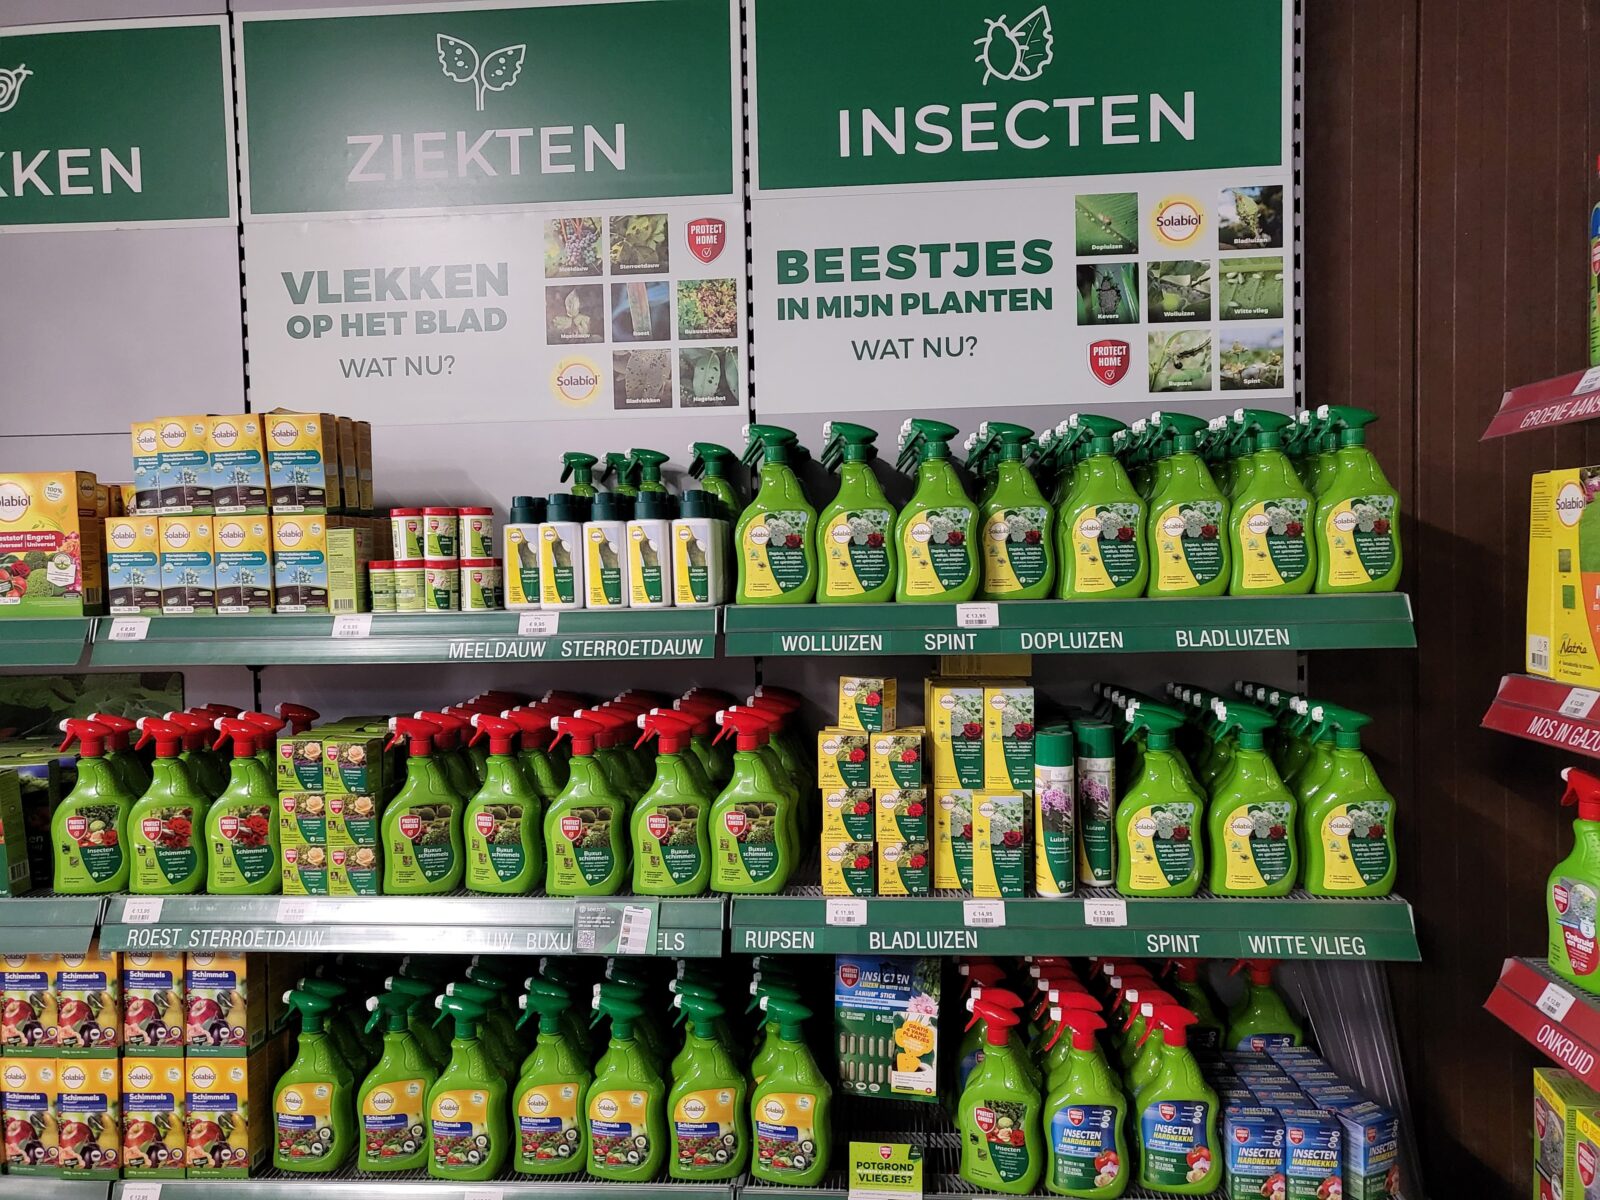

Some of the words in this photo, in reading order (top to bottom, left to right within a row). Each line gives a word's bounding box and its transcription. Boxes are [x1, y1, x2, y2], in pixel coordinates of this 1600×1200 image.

[839, 91, 1196, 158] INSECTEN
[346, 123, 628, 184] ZIEKTEN
[1157, 215, 1201, 226] Solabiol
[691, 224, 722, 234] PROTECT
[696, 235, 717, 244] HOME
[777, 238, 1054, 286] BEESTJES
[280, 261, 510, 306] VLEKKEN
[777, 297, 809, 321] IN
[817, 292, 893, 319] MIJN
[901, 287, 1053, 316] PLANTEN
[286, 313, 334, 341] OP
[340, 309, 411, 338] HET
[415, 305, 508, 336] BLAD
[851, 336, 914, 361] WAT
[922, 335, 979, 358] NU?
[1093, 346, 1127, 356] PROTECT
[339, 355, 397, 380] WAT
[403, 353, 457, 378] NU?
[1098, 357, 1121, 366] HOME
[556, 375, 598, 386] Solabiol
[1520, 402, 1572, 428] GROENE
[212, 430, 238, 438] Solabiol
[272, 429, 298, 437] Solabiol
[1556, 497, 1586, 510] Solabiol
[27, 534, 55, 542] Engrais
[112, 531, 136, 540] Solabiol
[164, 531, 191, 539] Solabiol
[219, 531, 246, 539] Solabiol
[277, 530, 303, 538] Solabiol
[782, 635, 882, 652] WOLLUIZEN
[924, 633, 977, 650] SPINT
[1020, 631, 1124, 650] DOPLUIZEN
[1176, 628, 1290, 648] BLADLUIZEN
[449, 641, 547, 659] MEELDAUW
[561, 638, 704, 658] STERROETDAUW
[1527, 716, 1558, 738] MOS
[1554, 722, 1571, 742] IN
[126, 928, 182, 947] ROEST
[188, 930, 325, 949] STERROETDAUW
[526, 932, 571, 949] BUXU
[745, 930, 815, 950] RUPSEN
[869, 930, 978, 950] BLADLUIZEN
[1147, 934, 1200, 952] SPINT
[1565, 931, 1594, 948] Onkruid
[1248, 935, 1308, 955] WITTE
[1310, 936, 1366, 956] VLIEG
[1567, 939, 1575, 947] en
[1577, 944, 1592, 954] mos
[909, 1023, 928, 1033] GRATIS
[1536, 1024, 1594, 1074] ONKRUID
[976, 1109, 993, 1118] PROTECT
[1063, 1128, 1101, 1139] INSECTEN
[1155, 1124, 1193, 1135] INSECTEN
[1062, 1137, 1101, 1146] HARDNEKKIG
[1153, 1132, 1193, 1142] HARDNEKKIG
[995, 1145, 1021, 1153] Insecten
[1239, 1148, 1281, 1157] INSECTEN
[1369, 1139, 1397, 1156] INSECTEN
[1293, 1148, 1337, 1160] INSECTEN
[856, 1161, 914, 1171] POTGROND
[1237, 1157, 1282, 1165] HARDNEKKIG
[1292, 1158, 1338, 1168] HARDNEKKIG
[858, 1173, 912, 1184] VLIEGJES?
